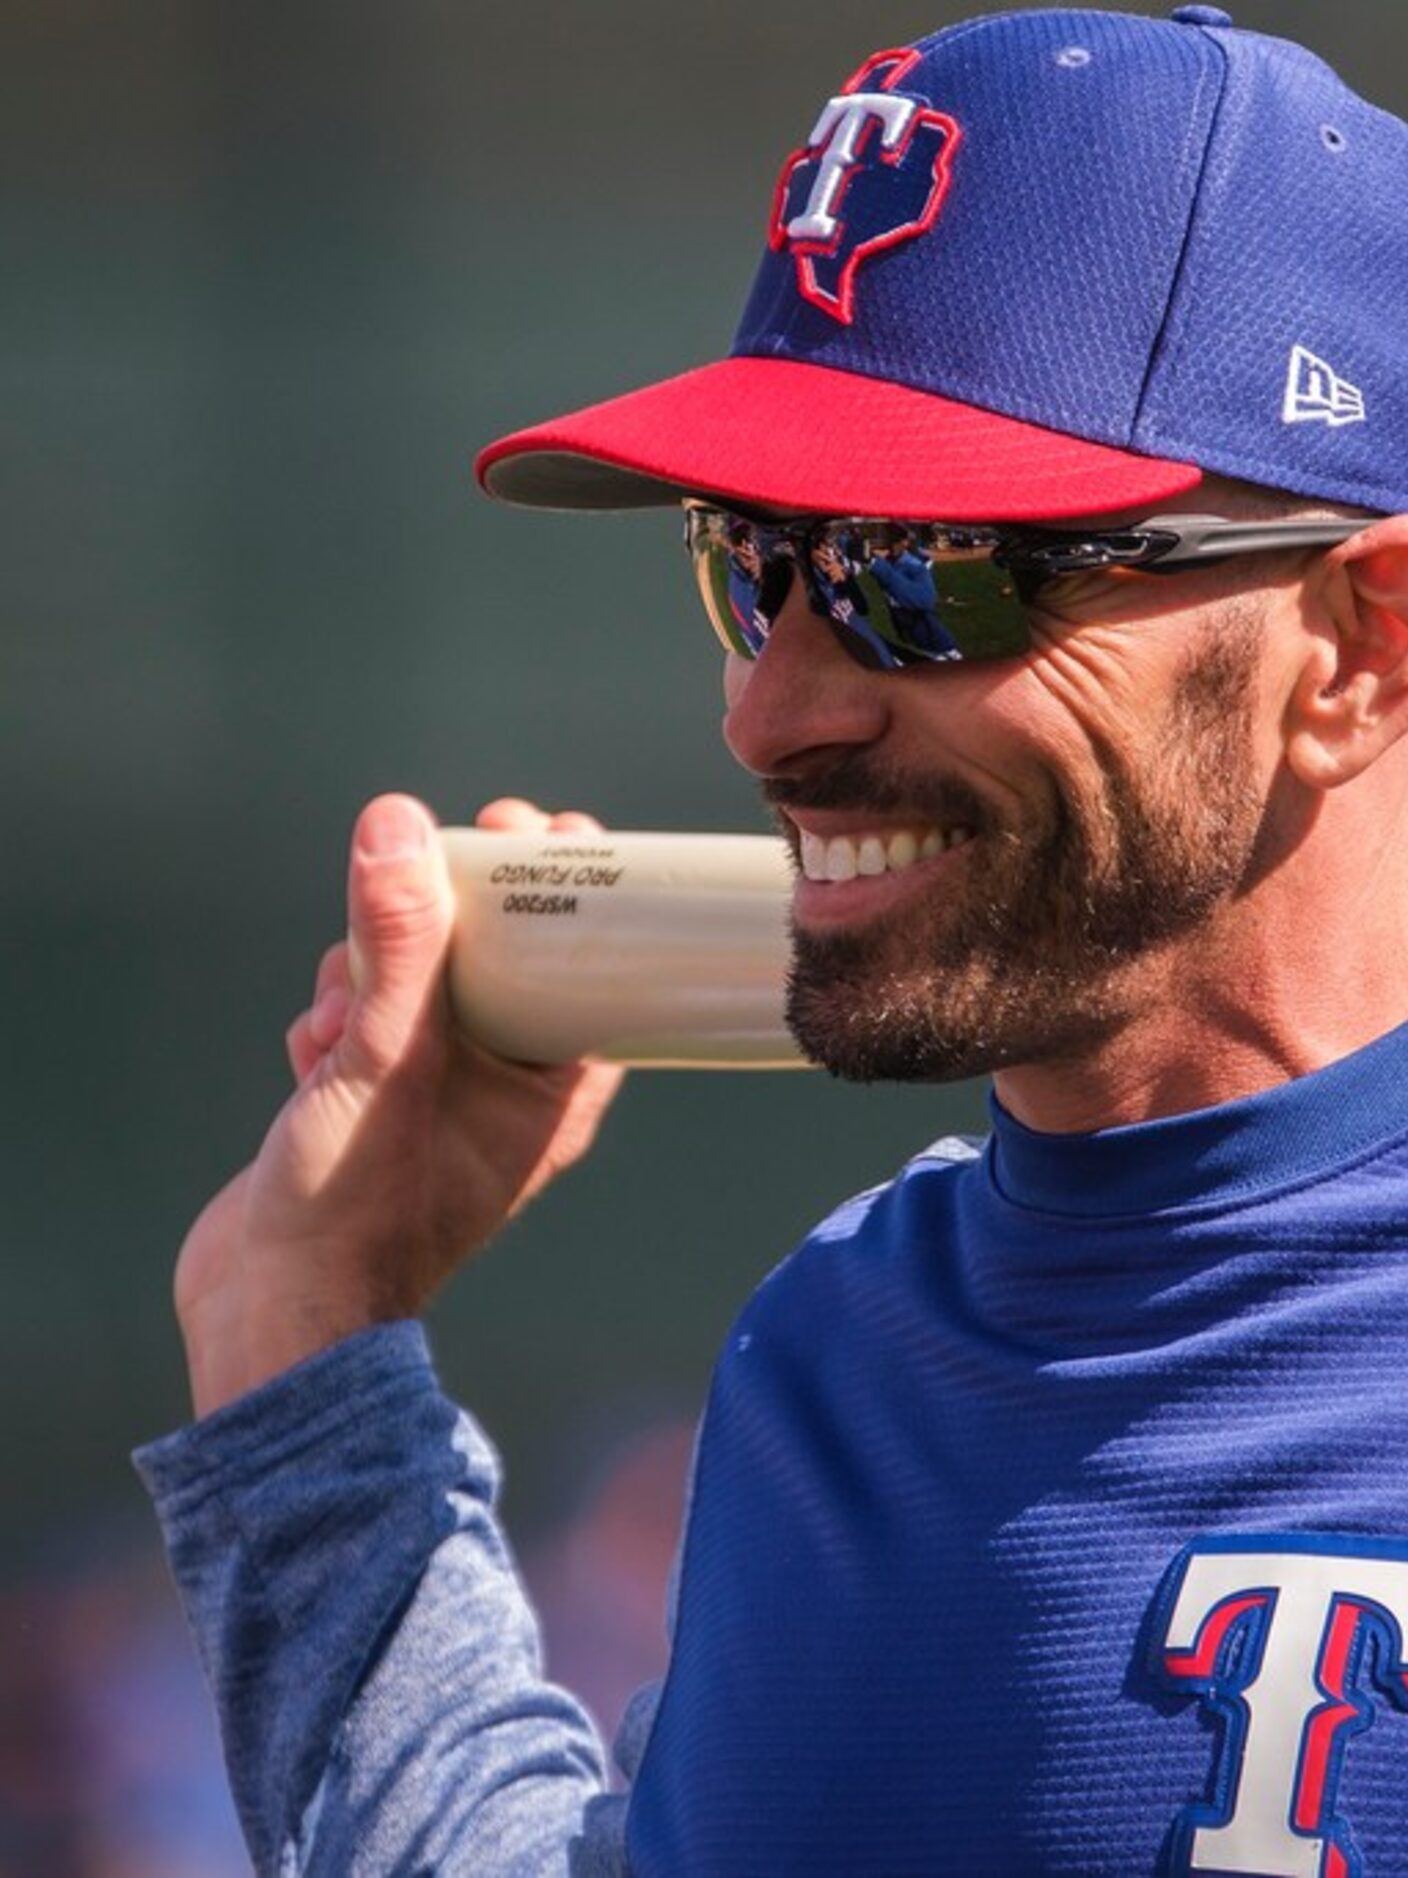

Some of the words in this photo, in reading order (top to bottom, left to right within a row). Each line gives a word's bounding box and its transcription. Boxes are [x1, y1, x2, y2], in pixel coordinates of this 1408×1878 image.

[786, 92, 917, 248] T
[490, 863, 571, 885] FUNGO
[573, 864, 625, 886] PRO
